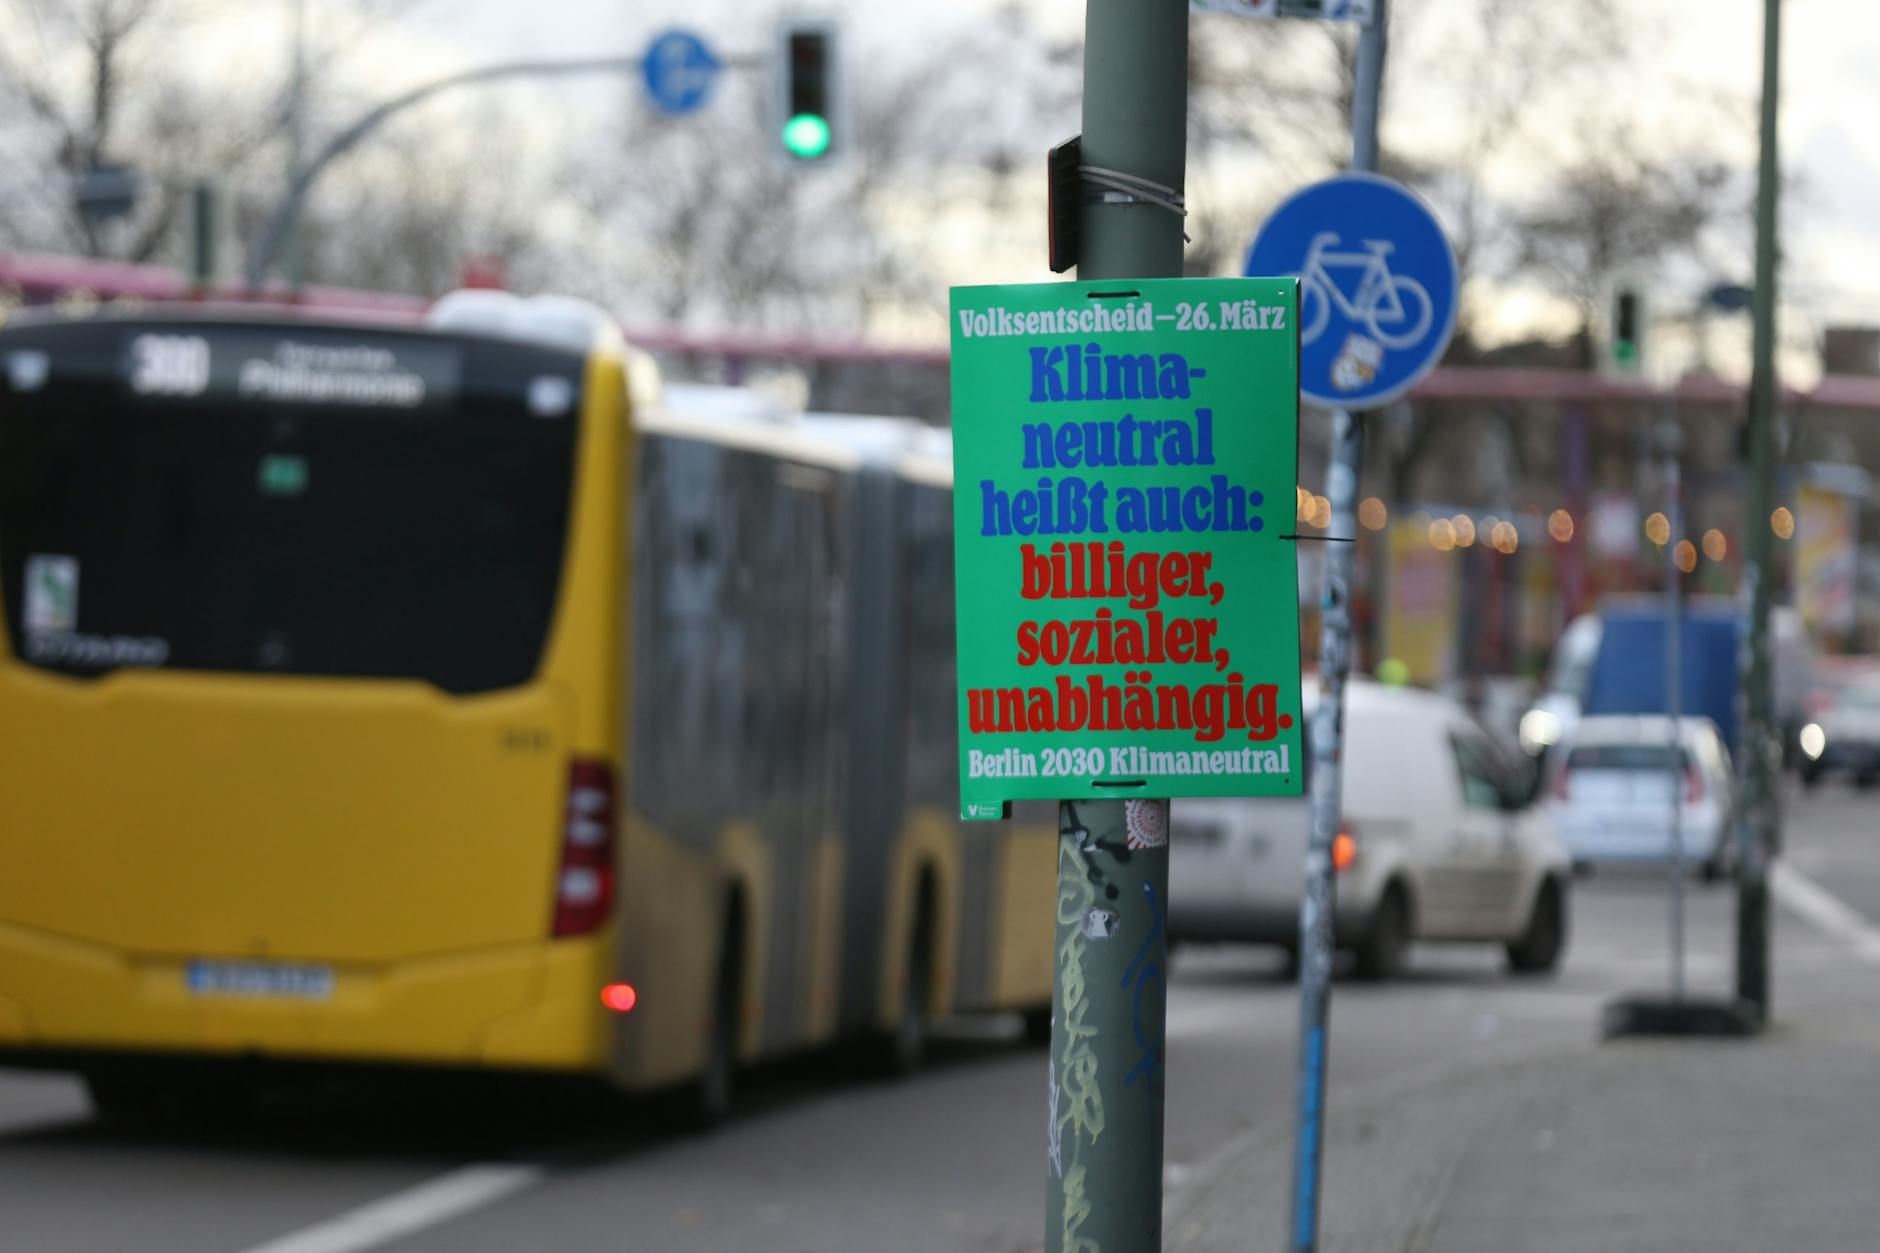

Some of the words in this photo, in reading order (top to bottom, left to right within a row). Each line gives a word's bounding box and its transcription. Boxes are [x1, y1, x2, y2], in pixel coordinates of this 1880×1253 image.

[960, 303, 1153, 337] Volksentscheid
[1220, 301, 1285, 330] März
[1029, 342, 1206, 402] Klima-
[1022, 408, 1216, 469] neutral
[980, 476, 1109, 537] heißt
[1115, 475, 1265, 533] auch:
[1020, 541, 1225, 610] billiger,
[1017, 607, 1230, 672] sozialer,
[967, 670, 1293, 742] unabhängig.
[969, 748, 1038, 778] Berlin
[1041, 747, 1105, 776] 2030
[1109, 744, 1290, 775] Klimaneutral
